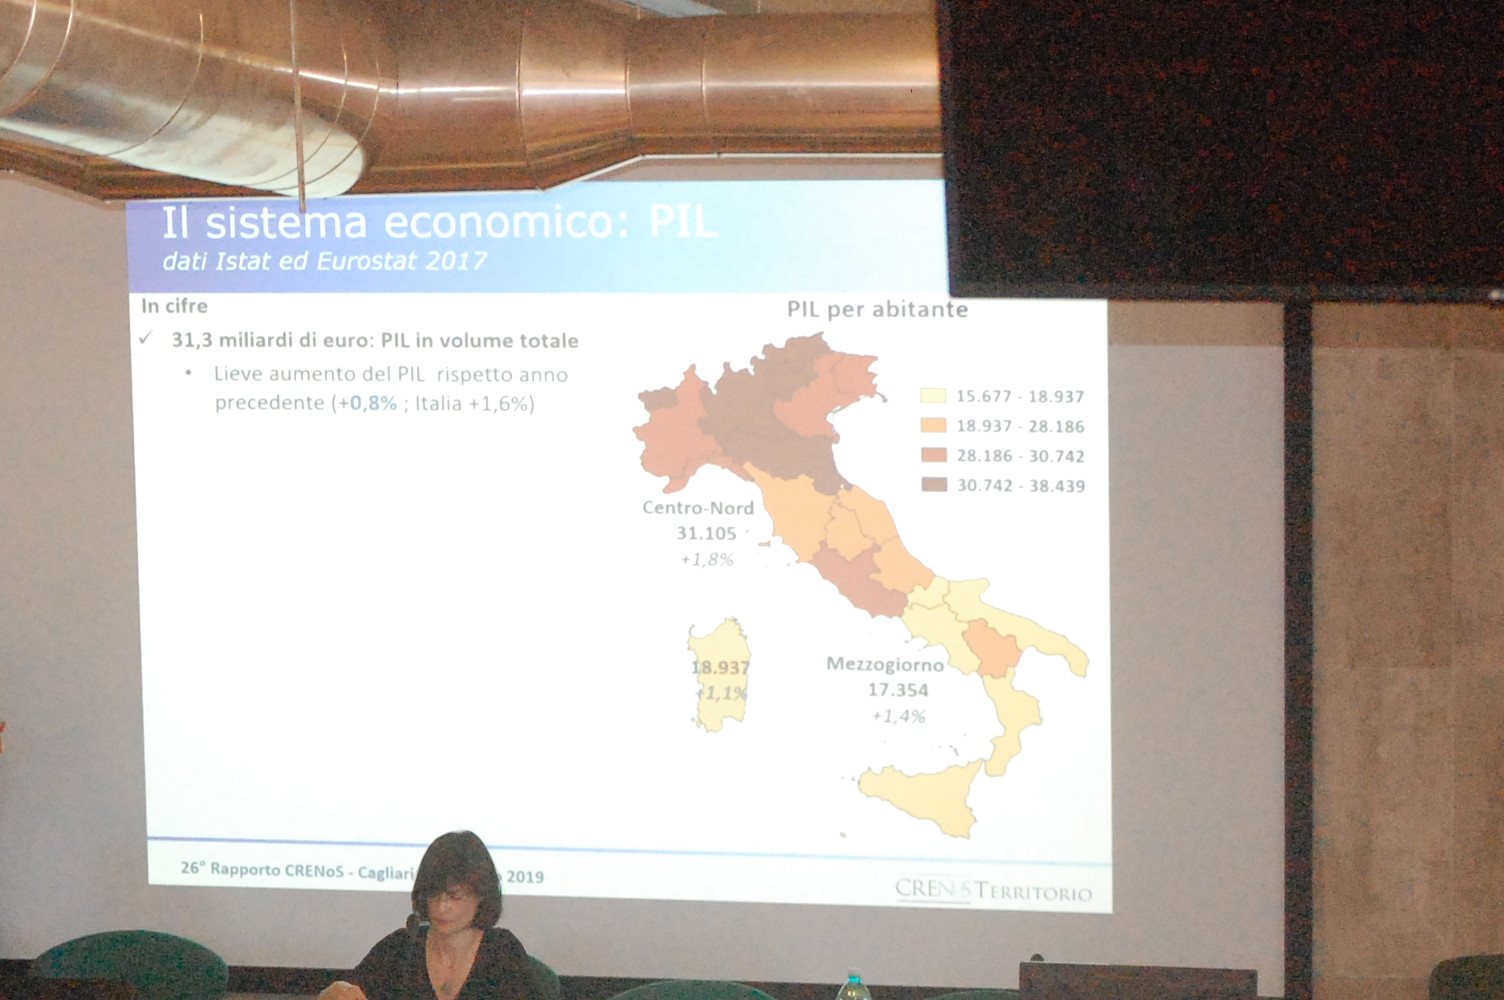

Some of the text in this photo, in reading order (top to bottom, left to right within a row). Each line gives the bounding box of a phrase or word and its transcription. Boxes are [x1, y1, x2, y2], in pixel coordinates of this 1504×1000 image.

[162, 203, 720, 239] Il sistema economico: PIL
[163, 250, 488, 271] dati Istat ed Eurostat 2017
[142, 297, 208, 314] In cifre
[787, 300, 969, 322] PIL per abitante
[172, 331, 579, 351] 31,3 miliardi di euro: PIL in volume totale
[214, 365, 569, 386] Lieve aumento del PIL rispetto anno
[215, 394, 325, 414] precedente
[331, 393, 398, 415] (+0,8%
[416, 395, 462, 412] Italia
[469, 394, 535, 415] +1,6%)
[957, 389, 1012, 403] 15.677
[1030, 390, 1084, 404] 18.937
[957, 419, 1012, 433] 18.937
[1029, 419, 1085, 433] 28.186
[957, 448, 1013, 462] 28.186
[1029, 449, 1085, 463] 30.742
[957, 478, 1013, 493] 30.742
[1030, 479, 1086, 493] 38.439
[642, 500, 754, 516] Centro-Nord
[677, 526, 737, 541] 31.105
[682, 551, 734, 569] +1,8%
[691, 659, 751, 676] 18.937
[827, 655, 945, 675] Mezzogiorno
[695, 684, 748, 703] +1,1%
[869, 682, 929, 698] 17.354
[872, 709, 926, 726] +1,4%
[211, 862, 281, 881] Rapporto
[284, 864, 345, 880] CRENoS
[358, 866, 414, 883] Cagliari
[506, 870, 545, 885] 2019
